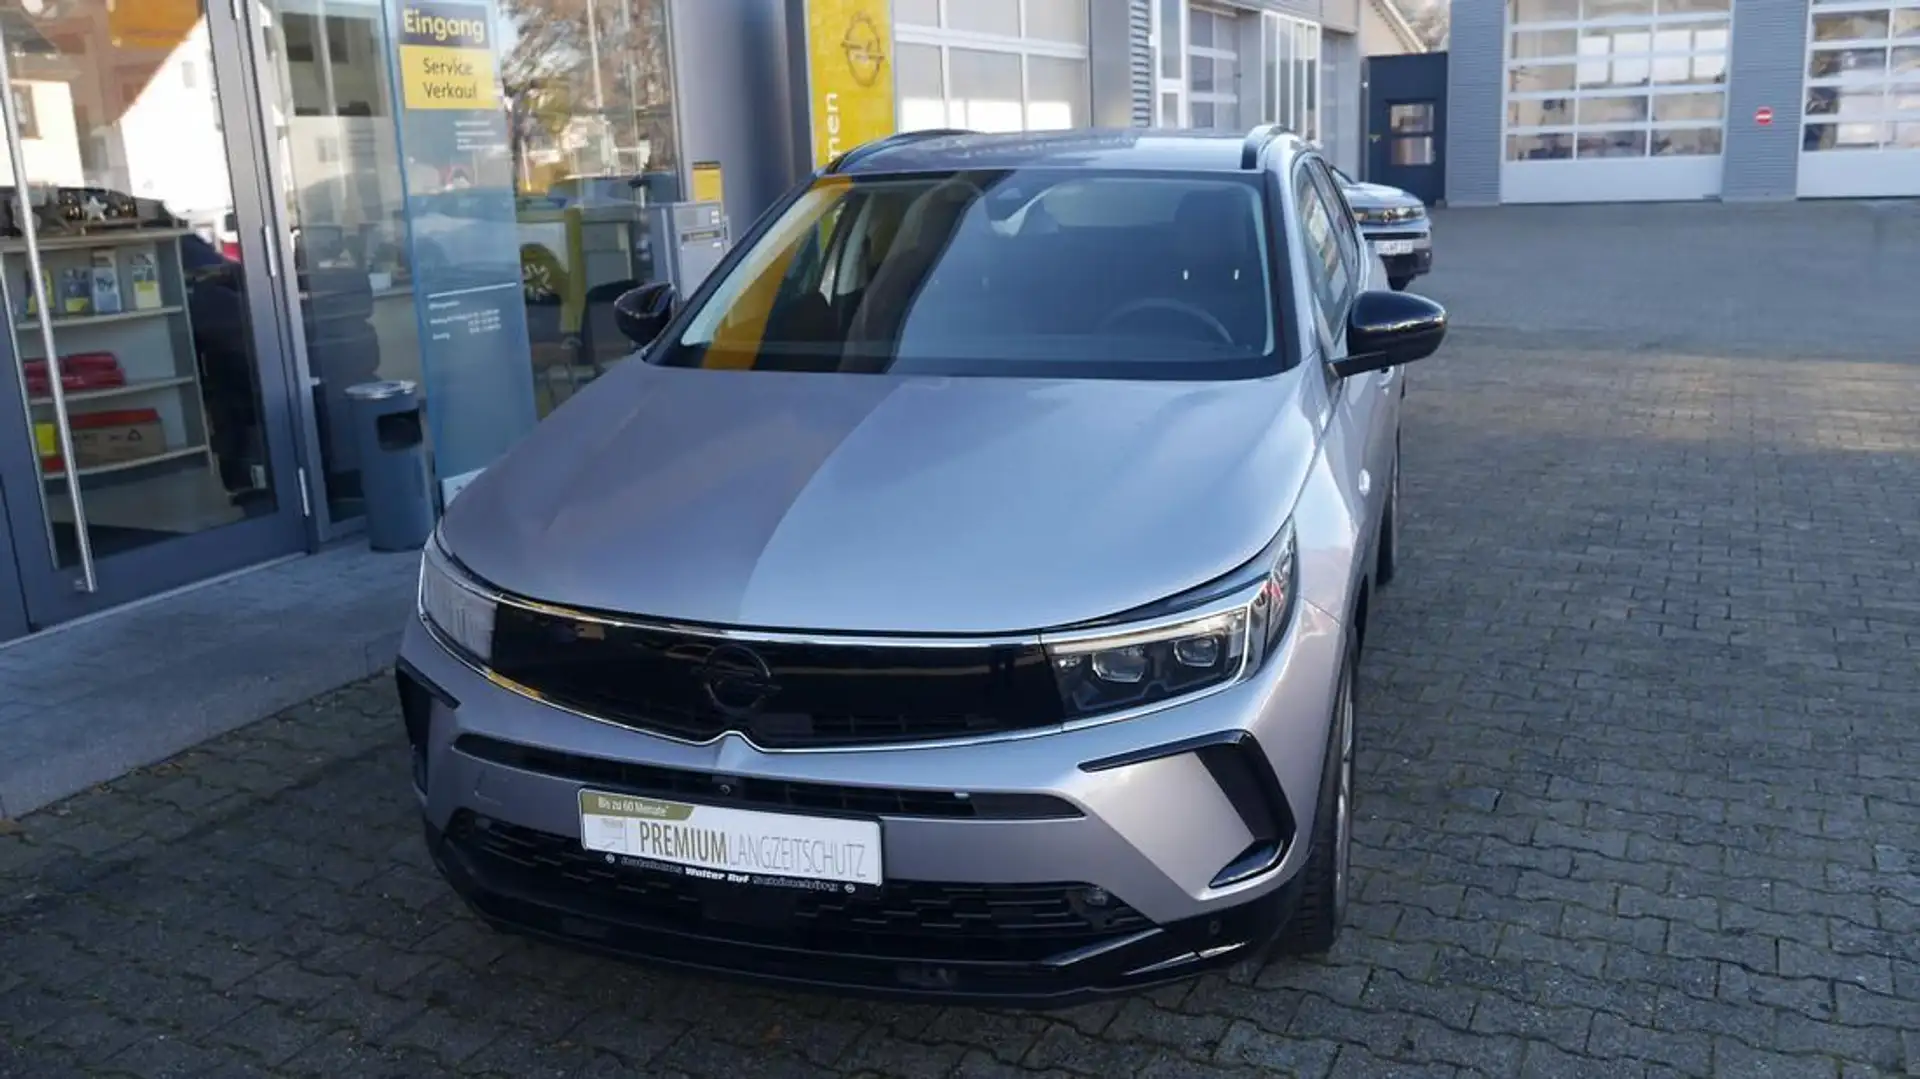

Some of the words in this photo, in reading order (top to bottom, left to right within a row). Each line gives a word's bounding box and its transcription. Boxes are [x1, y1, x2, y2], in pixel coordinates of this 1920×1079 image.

[403, 8, 485, 43] Eingang
[422, 57, 474, 76] Service
[422, 81, 478, 99] Verkauf
[622, 799, 635, 812] 60
[684, 866, 726, 881] Walter
[727, 872, 750, 884] Ruf
